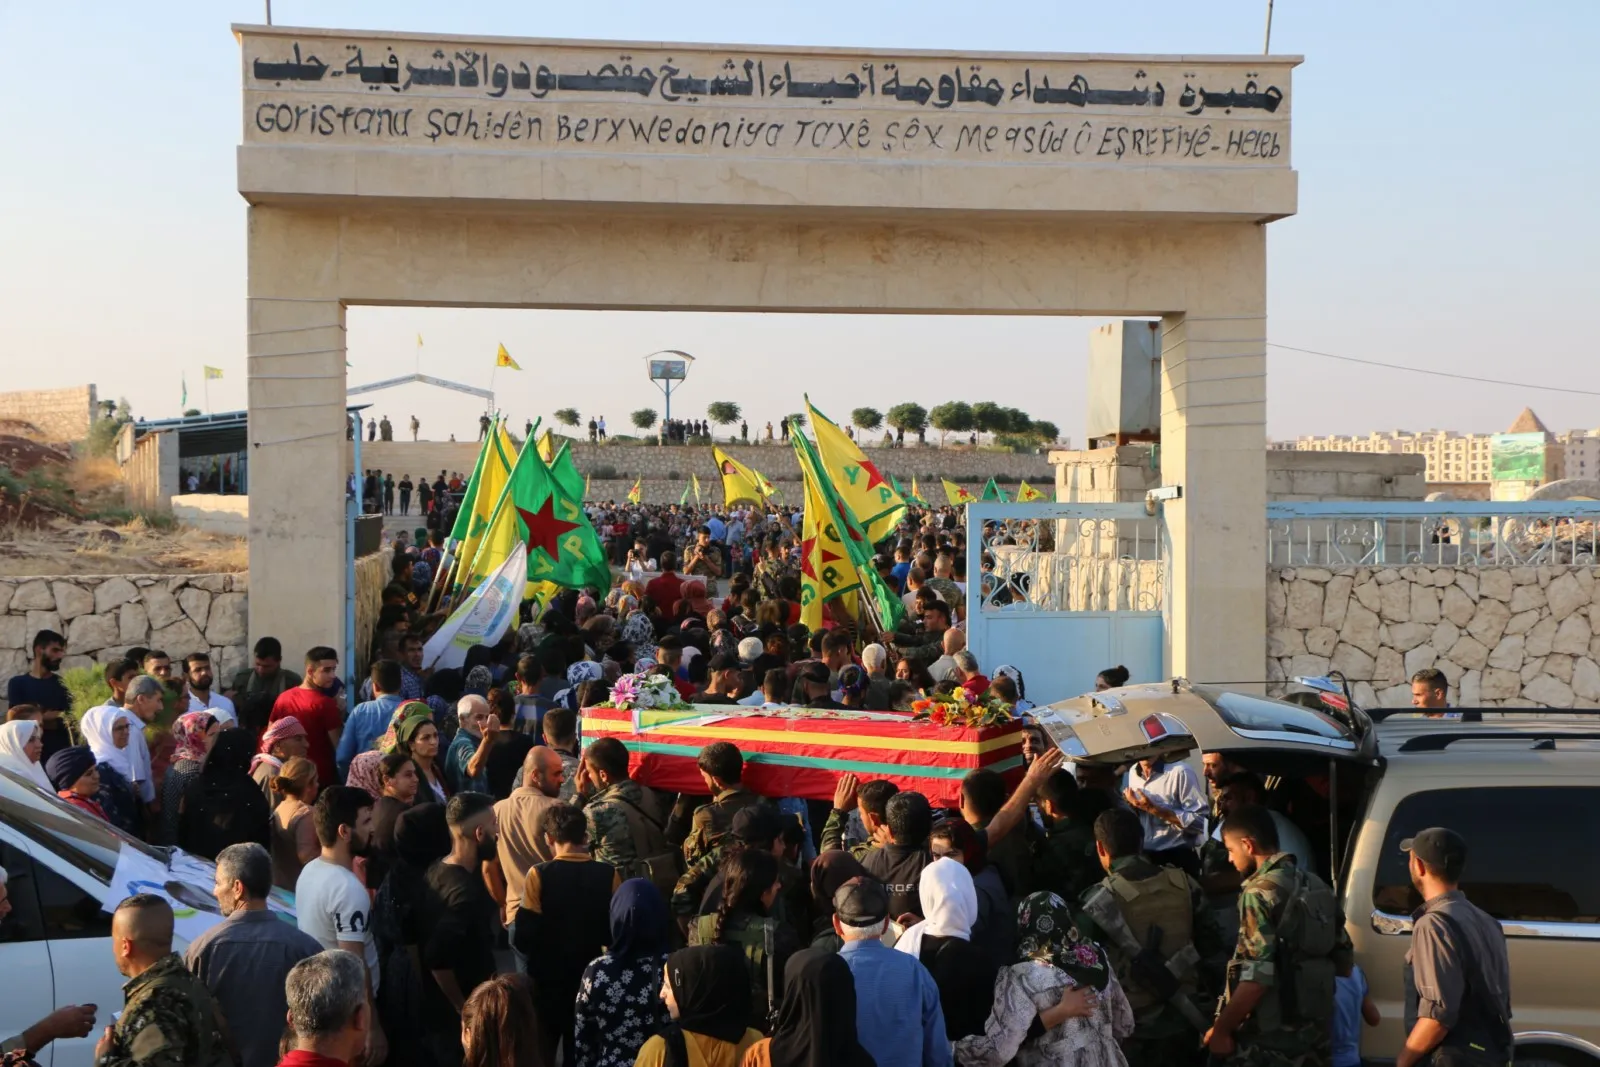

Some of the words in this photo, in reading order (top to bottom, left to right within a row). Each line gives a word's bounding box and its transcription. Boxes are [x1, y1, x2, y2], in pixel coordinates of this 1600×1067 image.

[659, 57, 765, 102] الشيخ
[882, 63, 1004, 108] مقاومة
[1010, 69, 1165, 107] شهداء
[1179, 72, 1284, 115] مقبرة
